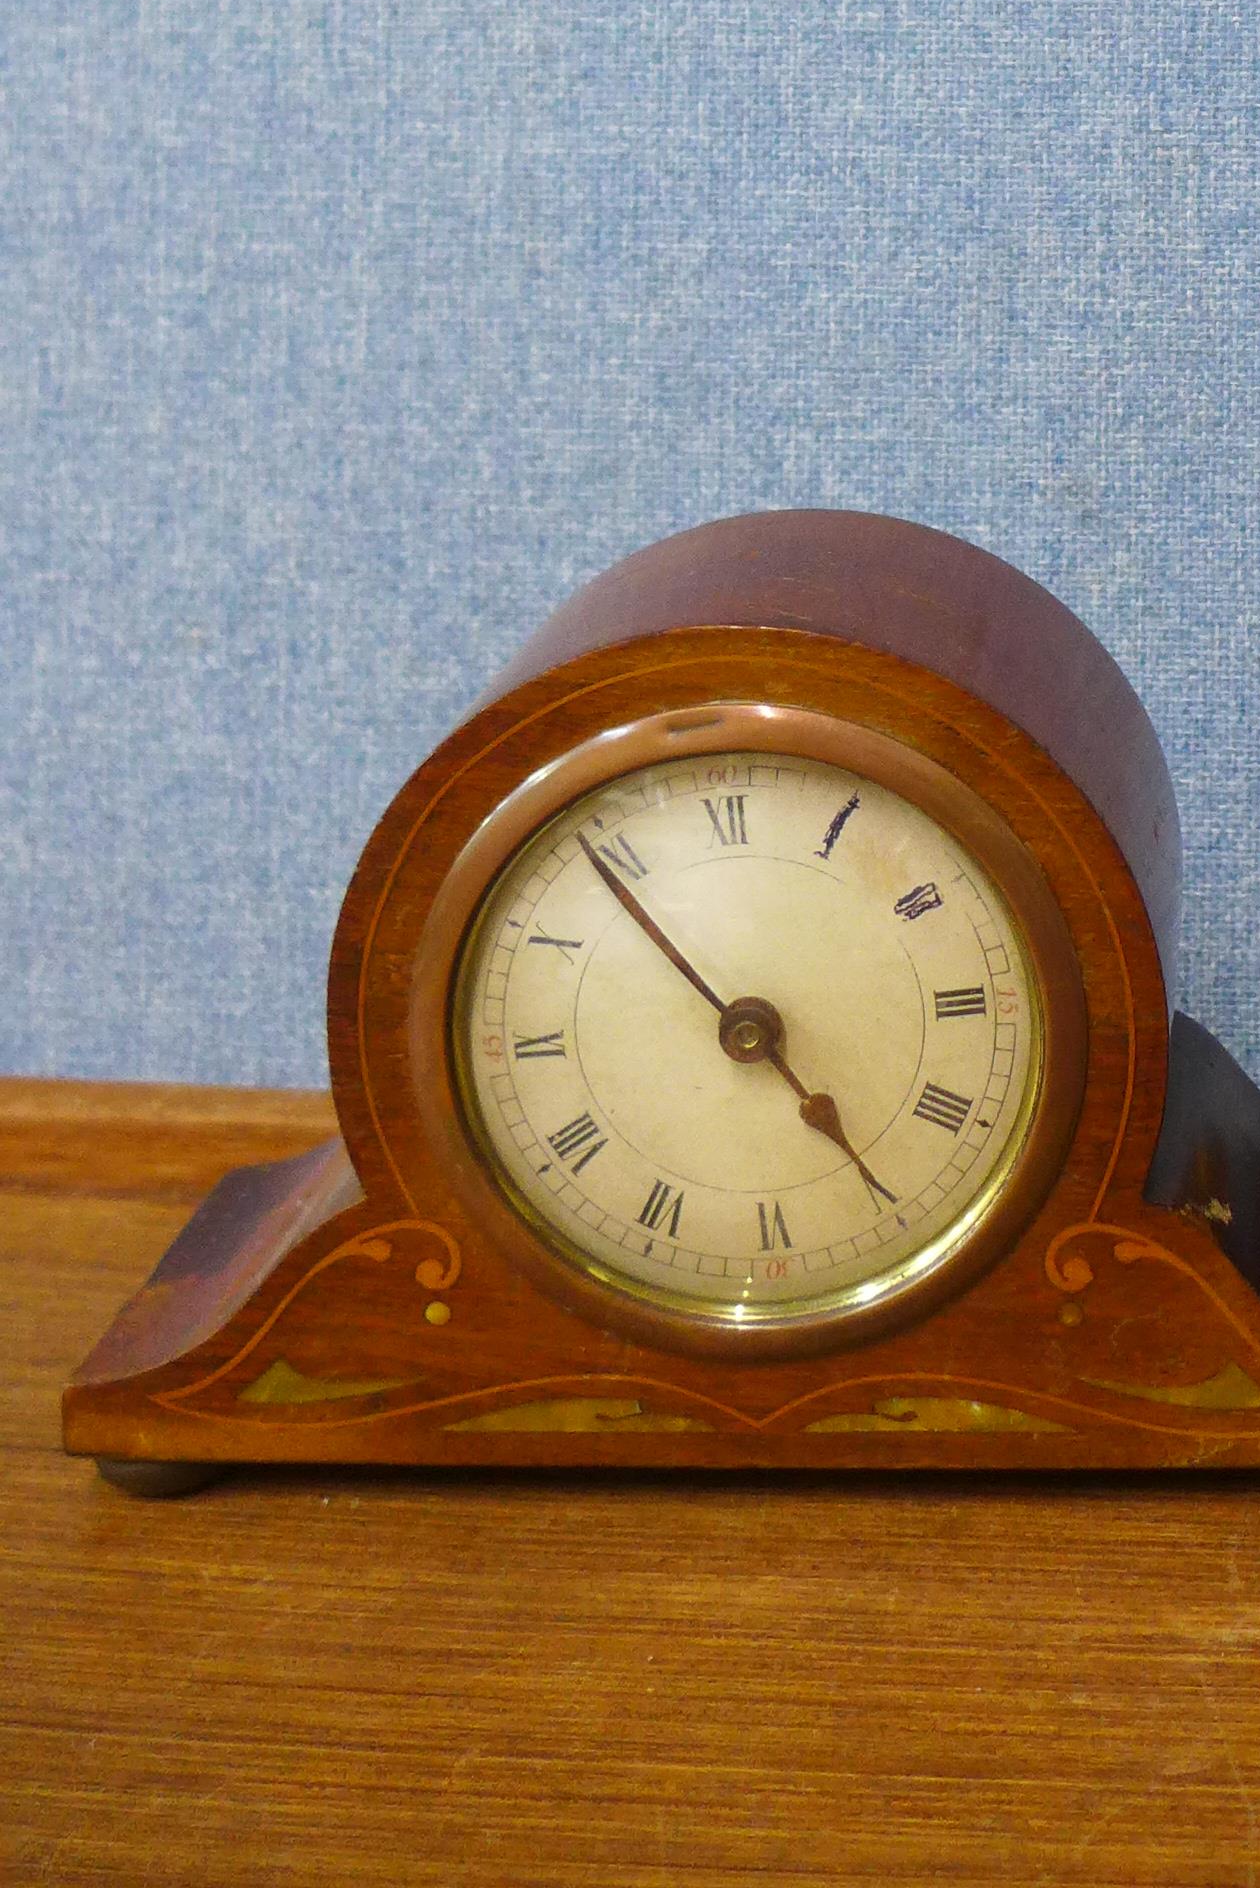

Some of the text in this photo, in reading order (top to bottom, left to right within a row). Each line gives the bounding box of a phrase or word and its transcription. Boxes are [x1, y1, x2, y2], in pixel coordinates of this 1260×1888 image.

[700, 794, 749, 848] XII
[934, 984, 987, 1020] III
[514, 1030, 567, 1059] IX
[912, 1082, 974, 1137] IIII
[547, 1112, 608, 1177] VIII
[635, 1177, 685, 1240] VII
[755, 1201, 794, 1251] VI
